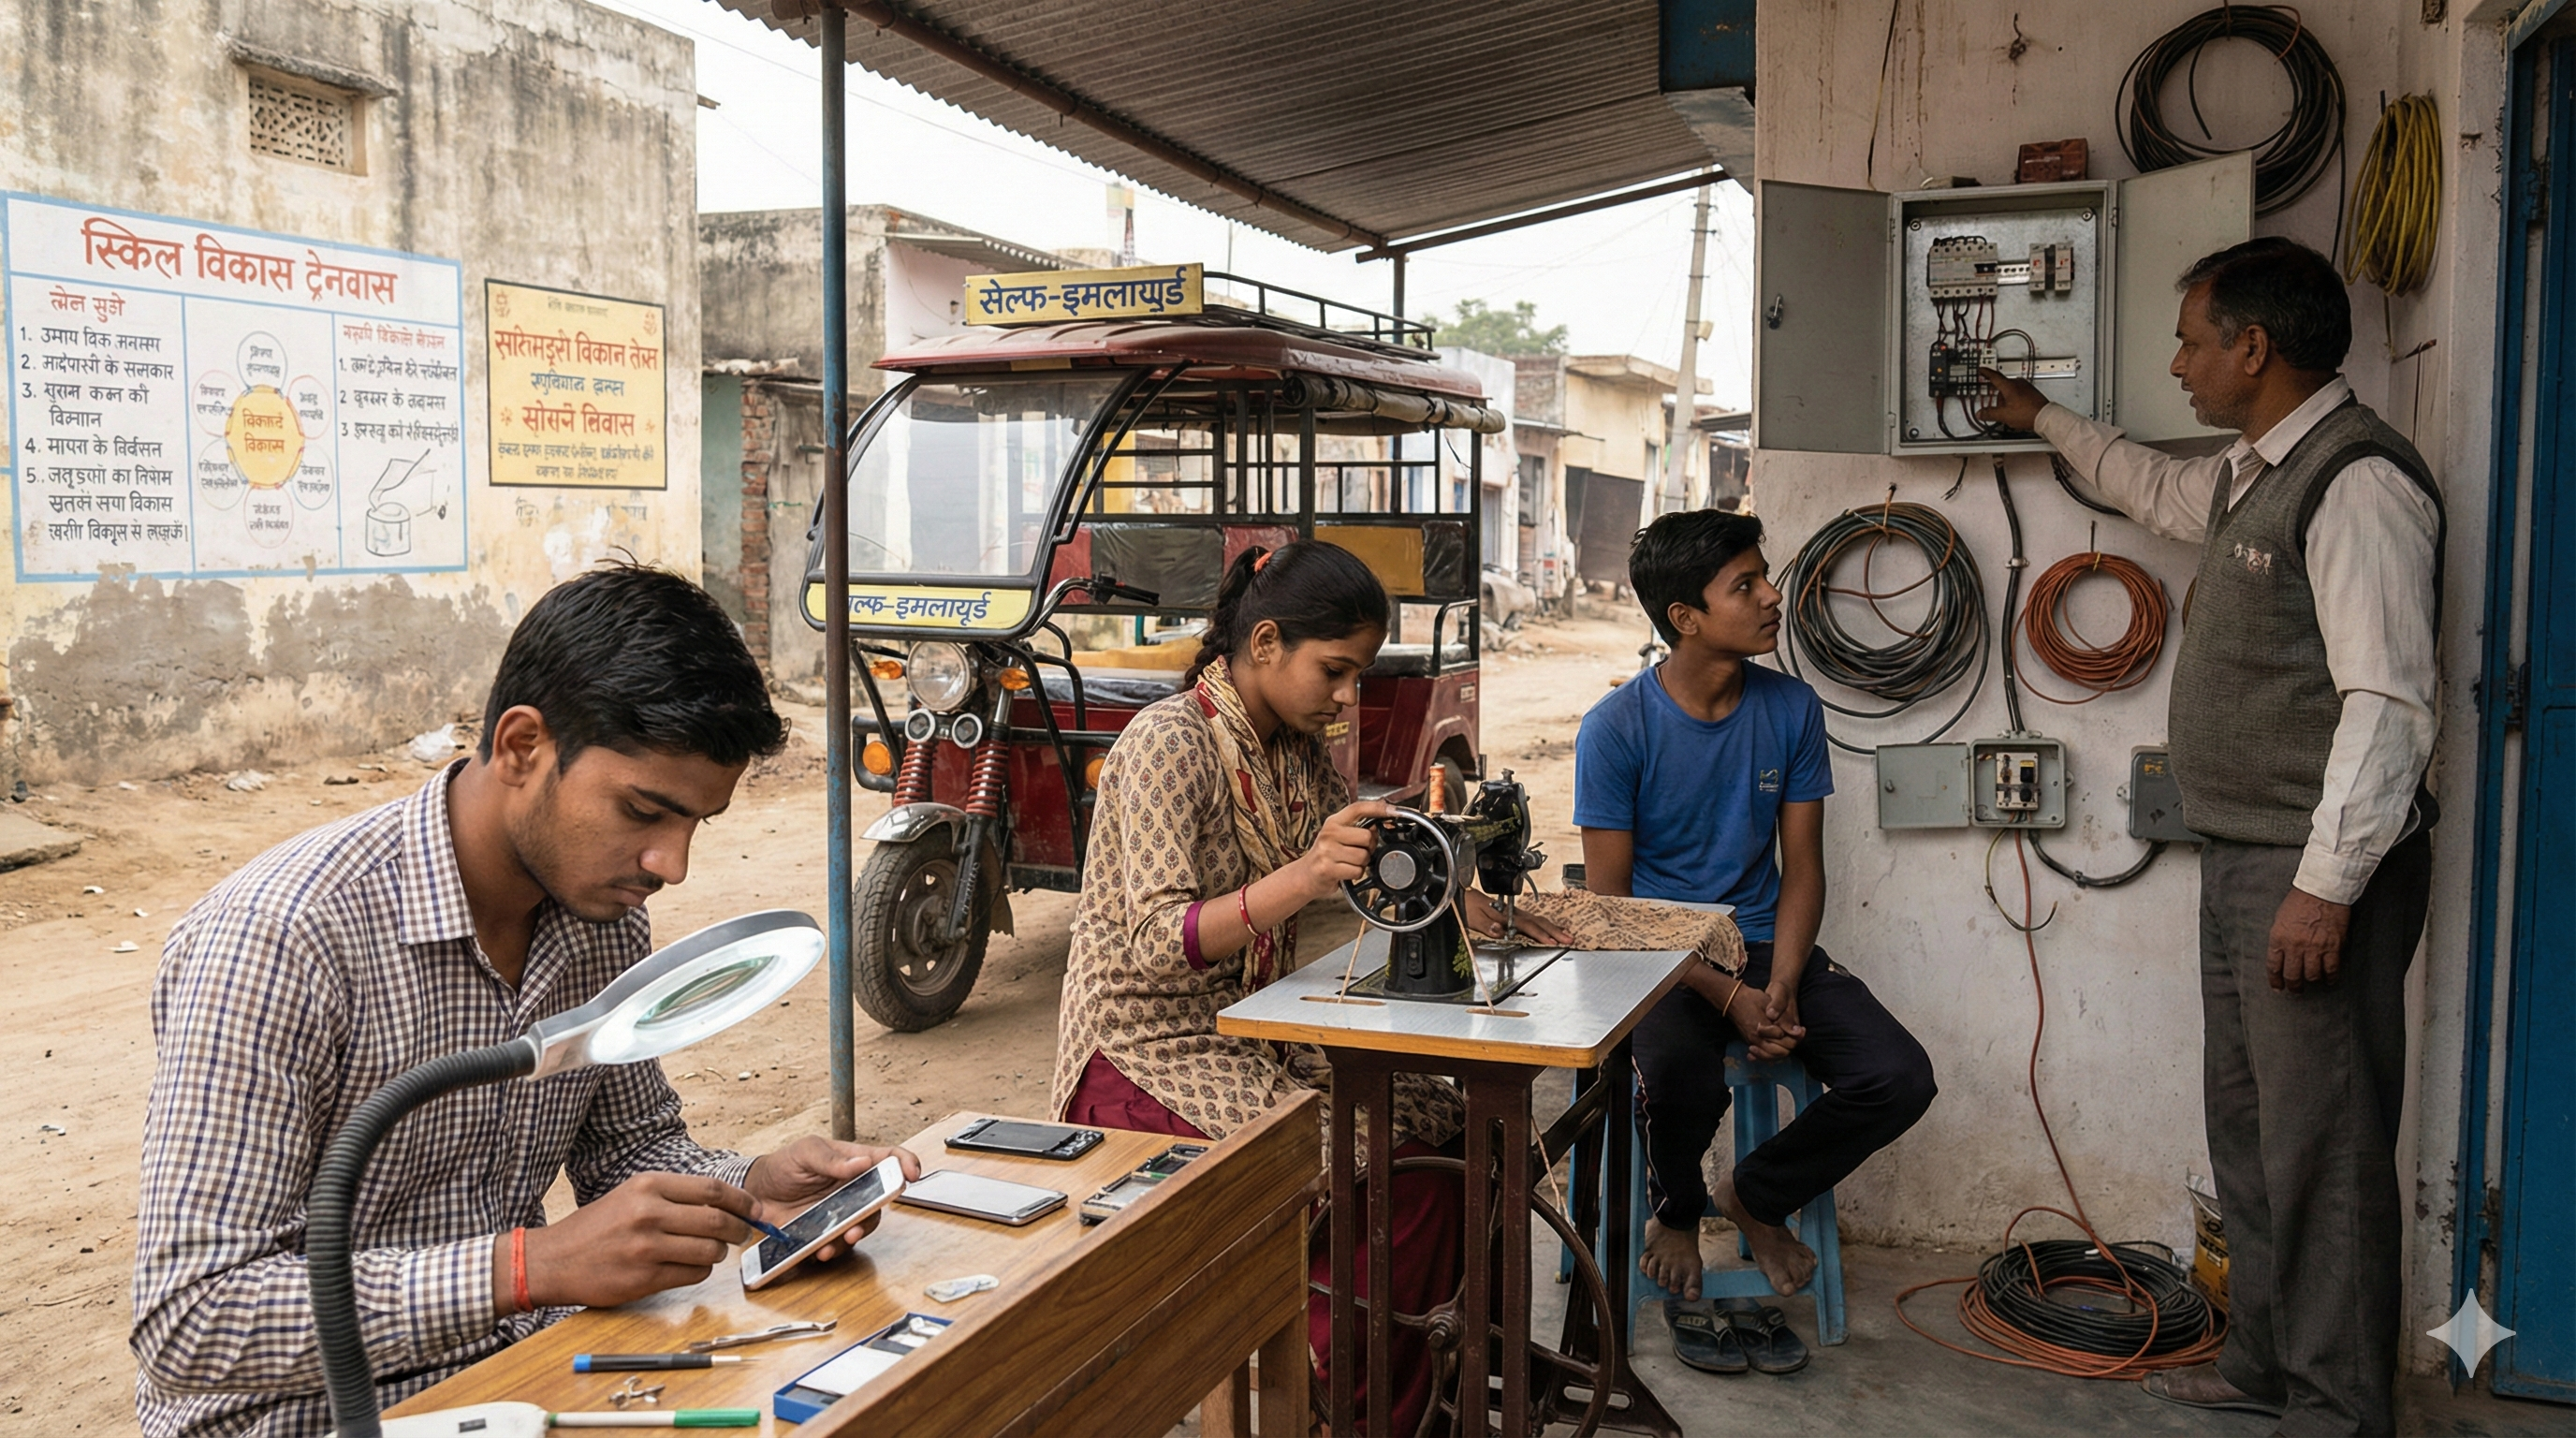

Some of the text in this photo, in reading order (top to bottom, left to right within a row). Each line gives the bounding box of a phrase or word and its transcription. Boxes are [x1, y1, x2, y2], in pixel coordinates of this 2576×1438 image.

[80, 217, 399, 305] स्किल विकास ट्रेनवास
[21, 326, 33, 341] 1.
[21, 353, 37, 371] 2.
[22, 382, 37, 399] 3.
[25, 437, 41, 455] 4.
[93, 433, 109, 456] के
[112, 468, 132, 486] का
[129, 490, 174, 513] विकास
[848, 591, 992, 626] ल्फ-इमलायूर्ड
